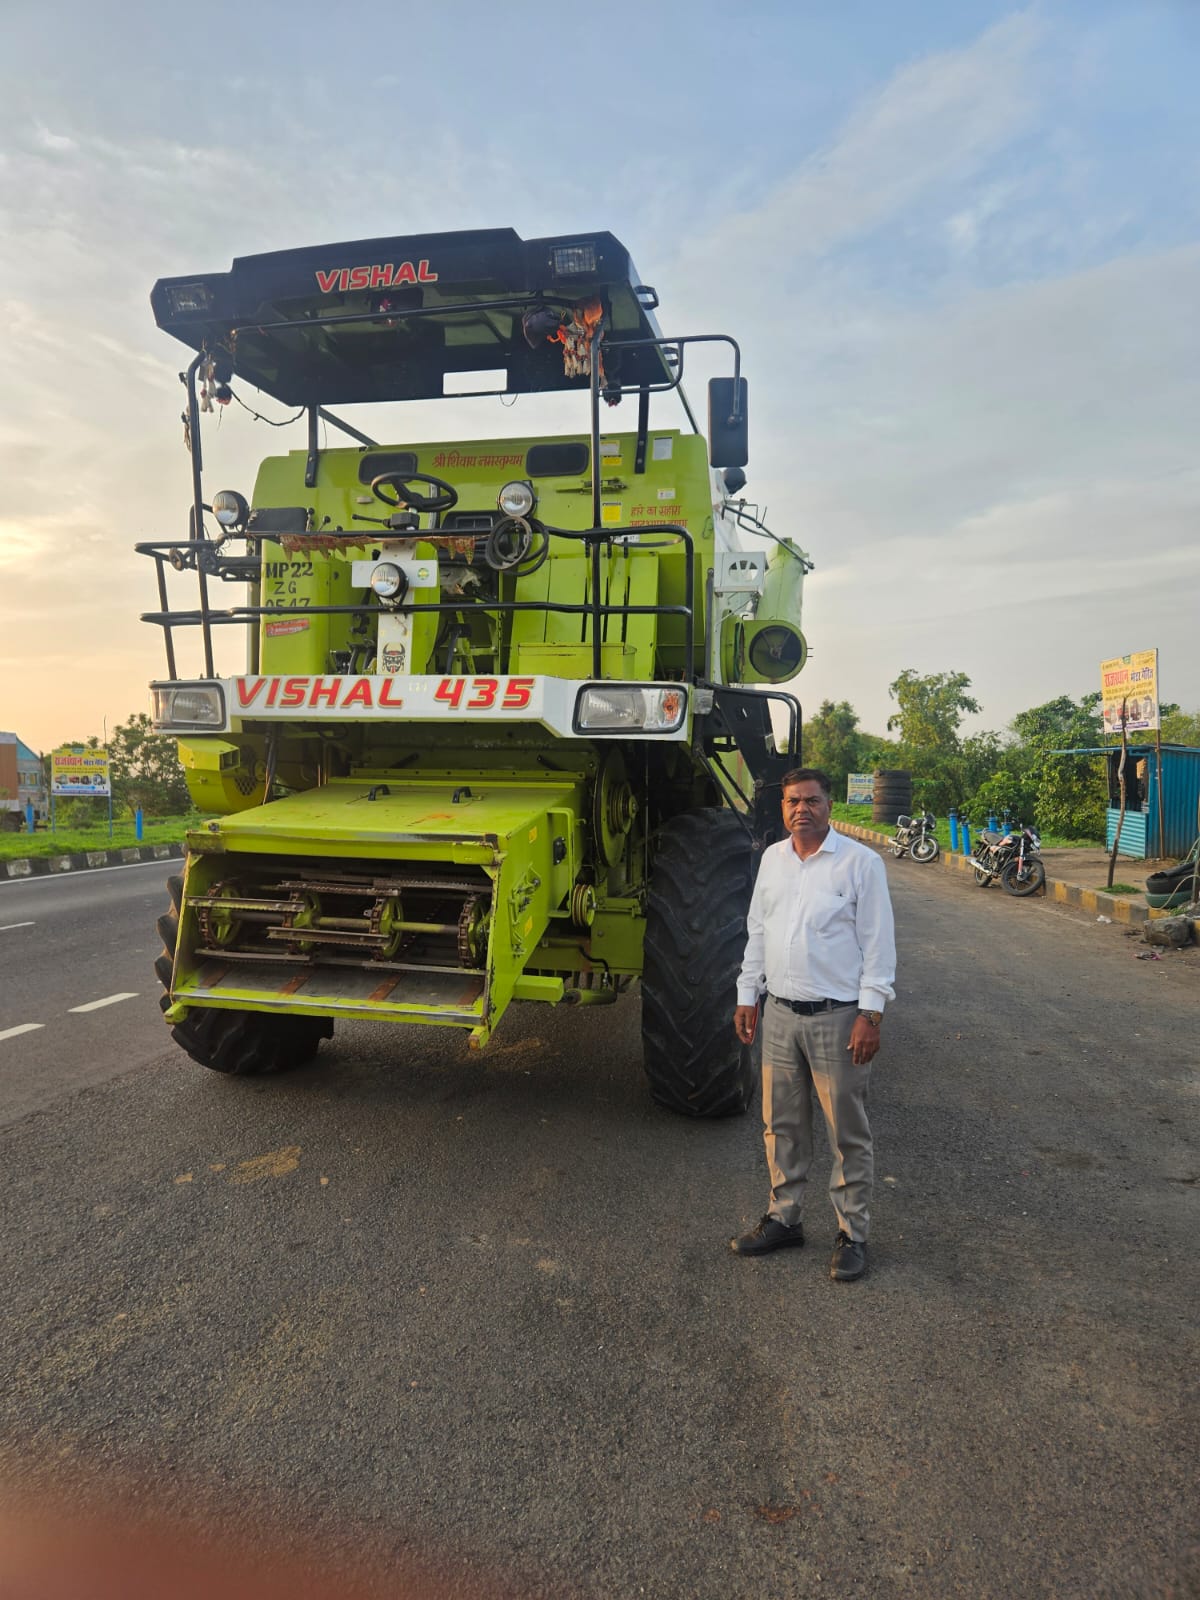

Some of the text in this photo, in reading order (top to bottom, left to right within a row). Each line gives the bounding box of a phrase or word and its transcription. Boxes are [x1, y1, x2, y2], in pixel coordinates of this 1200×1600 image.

[315, 260, 438, 293] VISHAL
[432, 452, 446, 469] श्री
[447, 449, 476, 469] शिवाय
[646, 506, 657, 516] का
[265, 561, 314, 578] MP22
[236, 677, 535, 709] VISHAL 435
